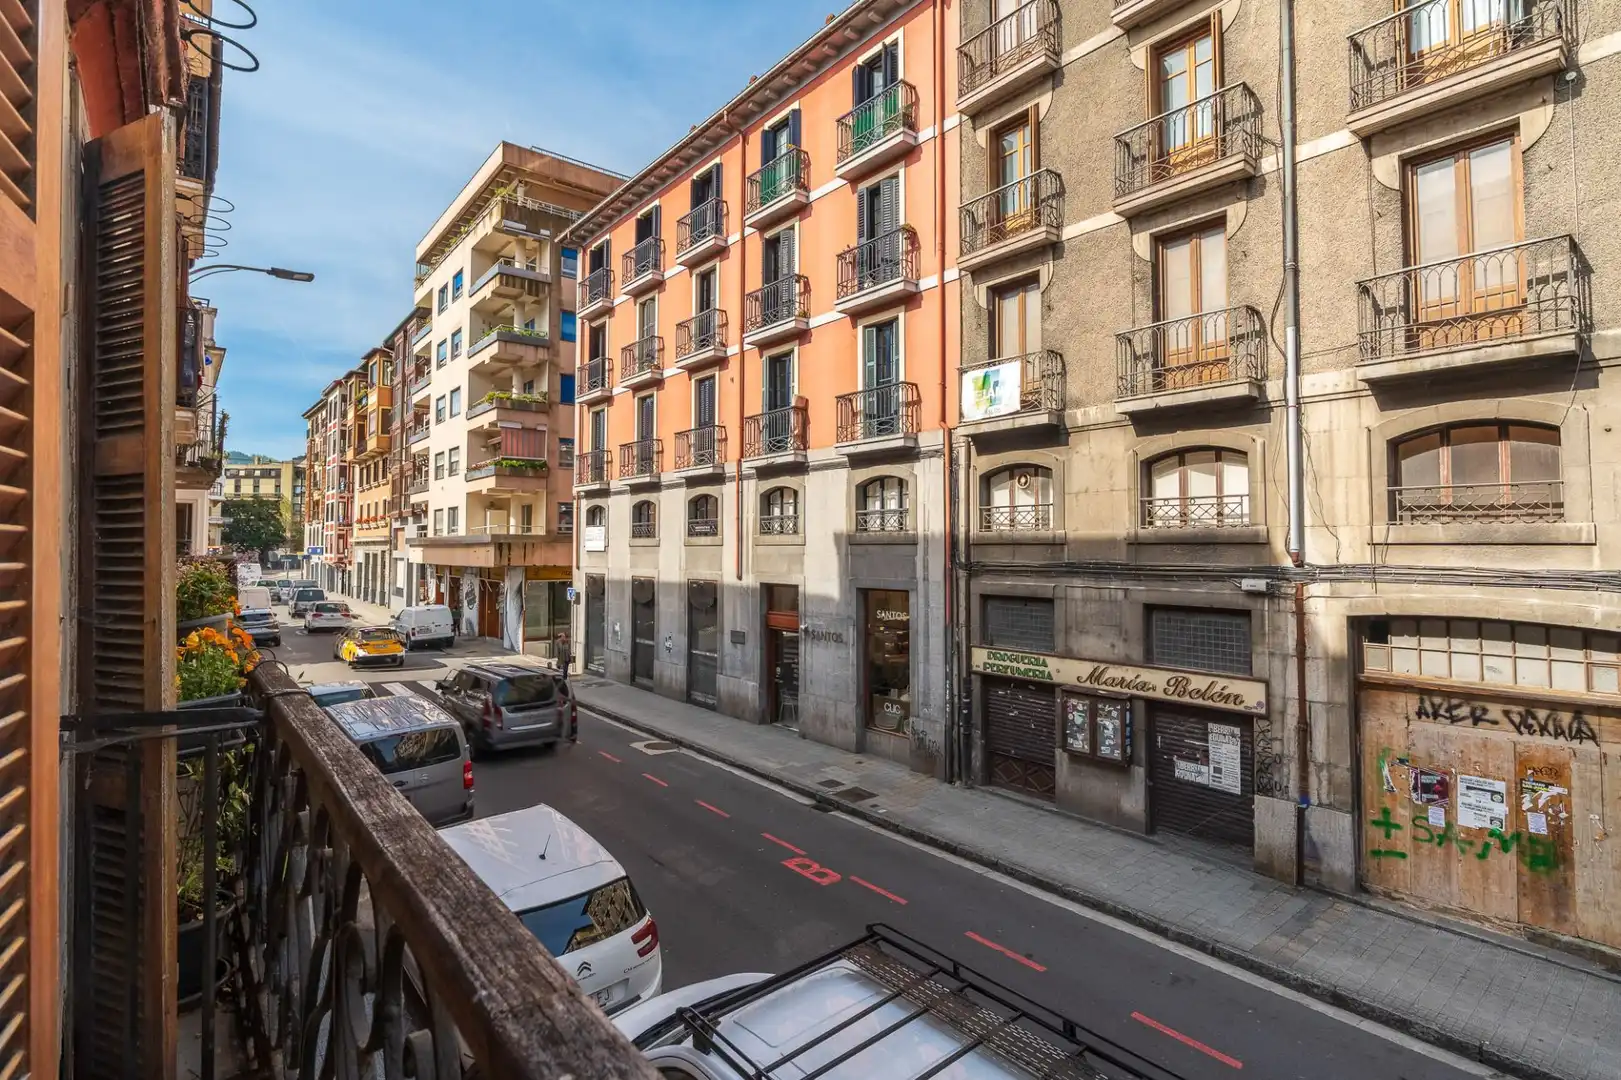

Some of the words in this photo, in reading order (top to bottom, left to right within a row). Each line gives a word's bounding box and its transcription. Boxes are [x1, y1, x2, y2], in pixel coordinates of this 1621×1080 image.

[876, 610, 908, 621] SANTOS
[811, 629, 844, 644] SANTOS
[986, 650, 1049, 668] DROGUERIA
[982, 661, 1054, 681] PERFUMERIA
[1076, 665, 1157, 693] María
[1162, 674, 1246, 707] Belén
[780, 856, 842, 886] B
